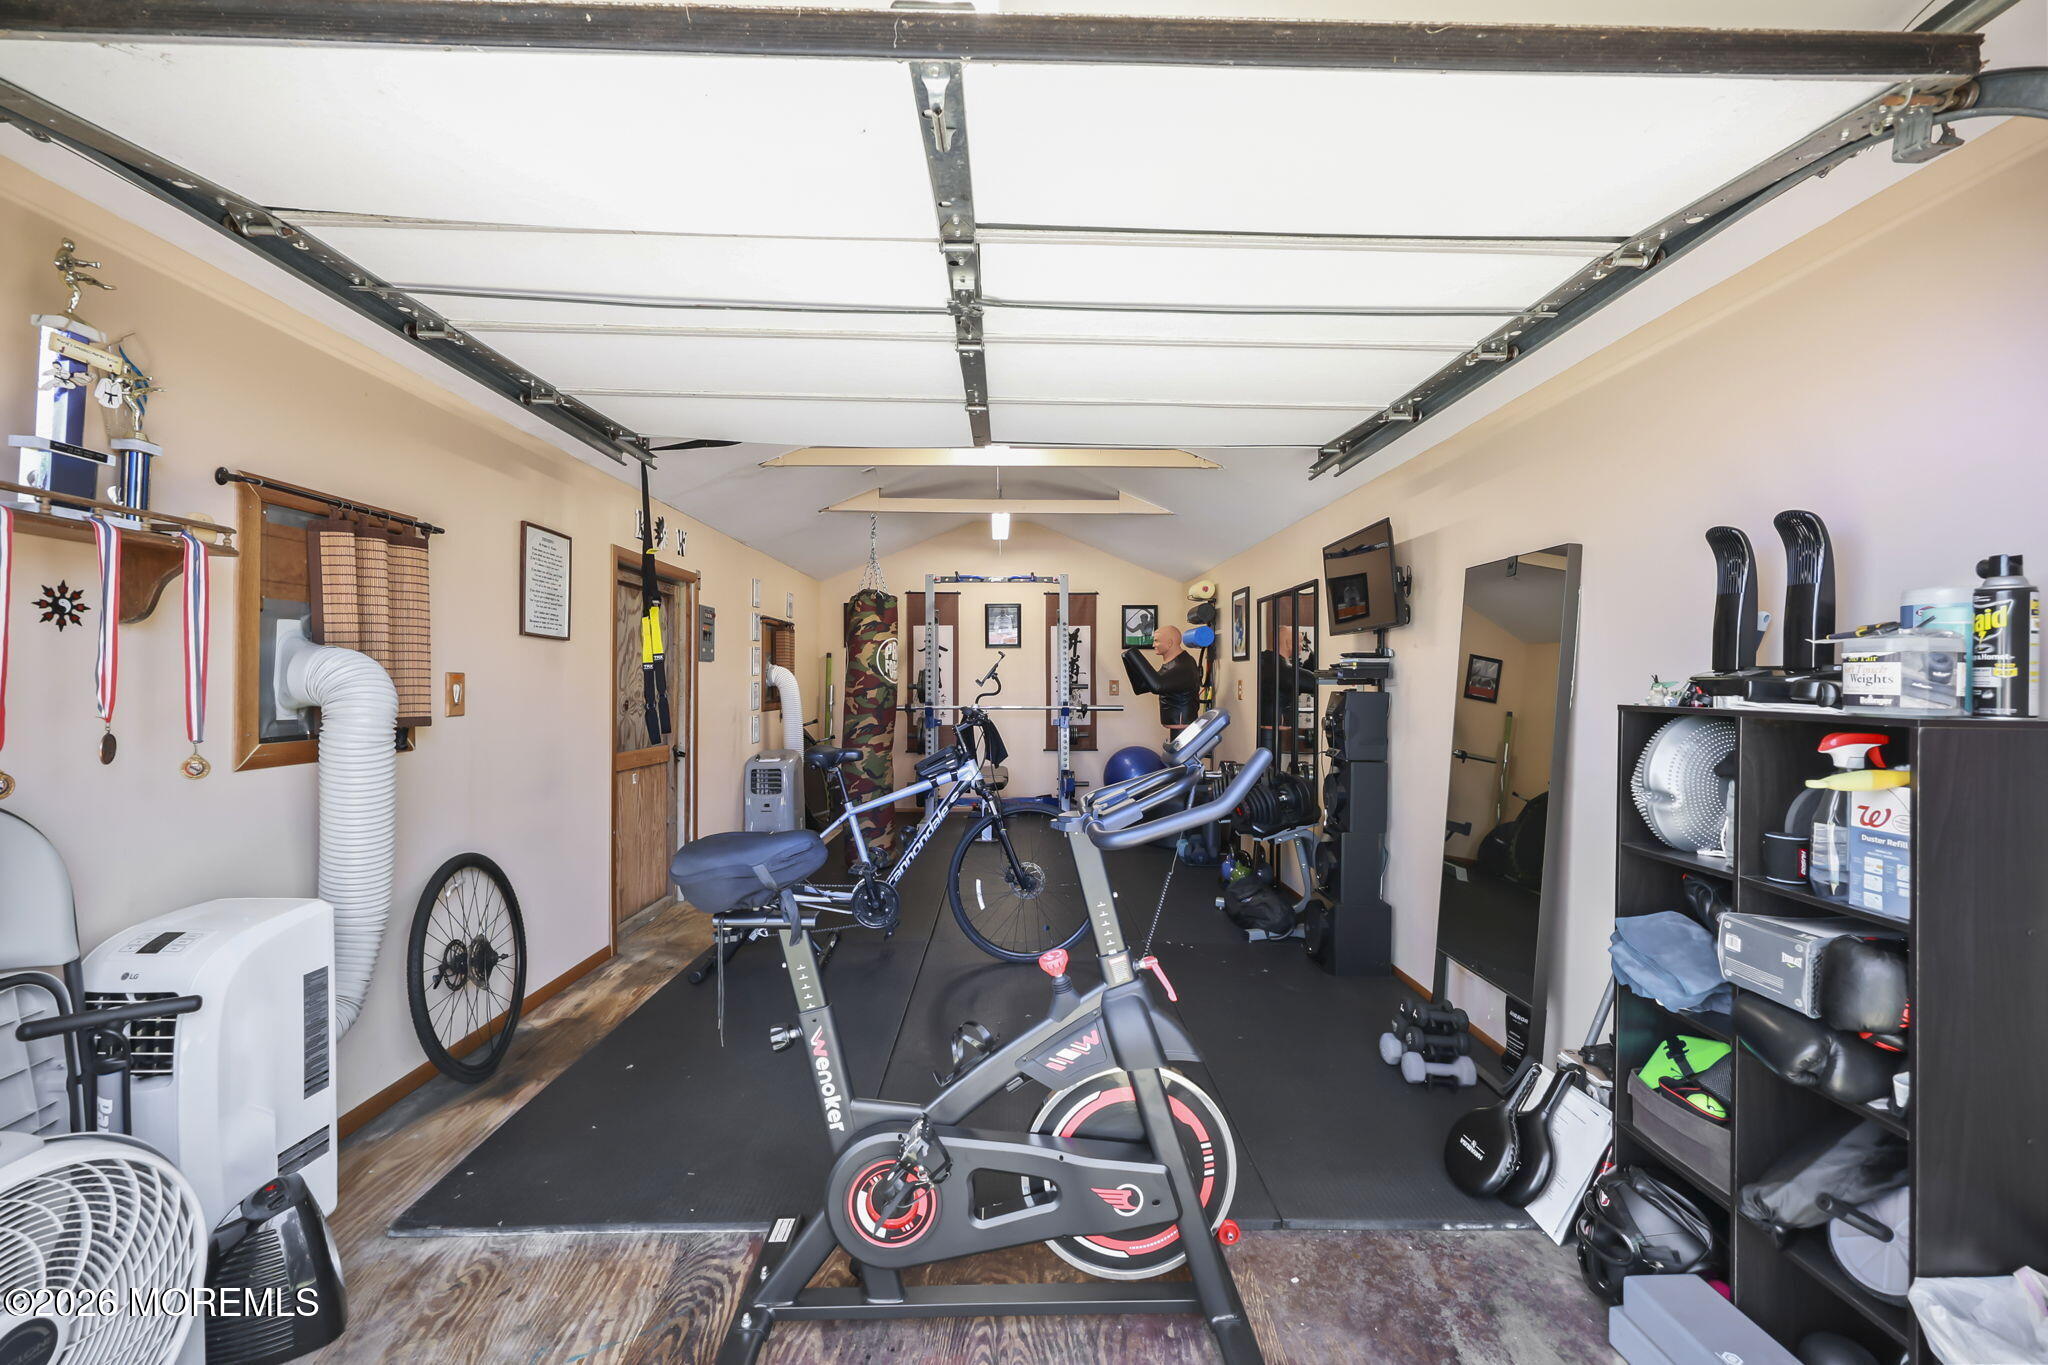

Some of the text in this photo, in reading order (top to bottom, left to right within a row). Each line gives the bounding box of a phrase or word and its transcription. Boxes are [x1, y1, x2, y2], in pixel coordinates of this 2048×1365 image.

[1973, 606, 2008, 633] aid
[1850, 673, 1894, 687] Weights
[888, 805, 949, 887] cannondale
[1861, 834, 1909, 850] Duster Refill
